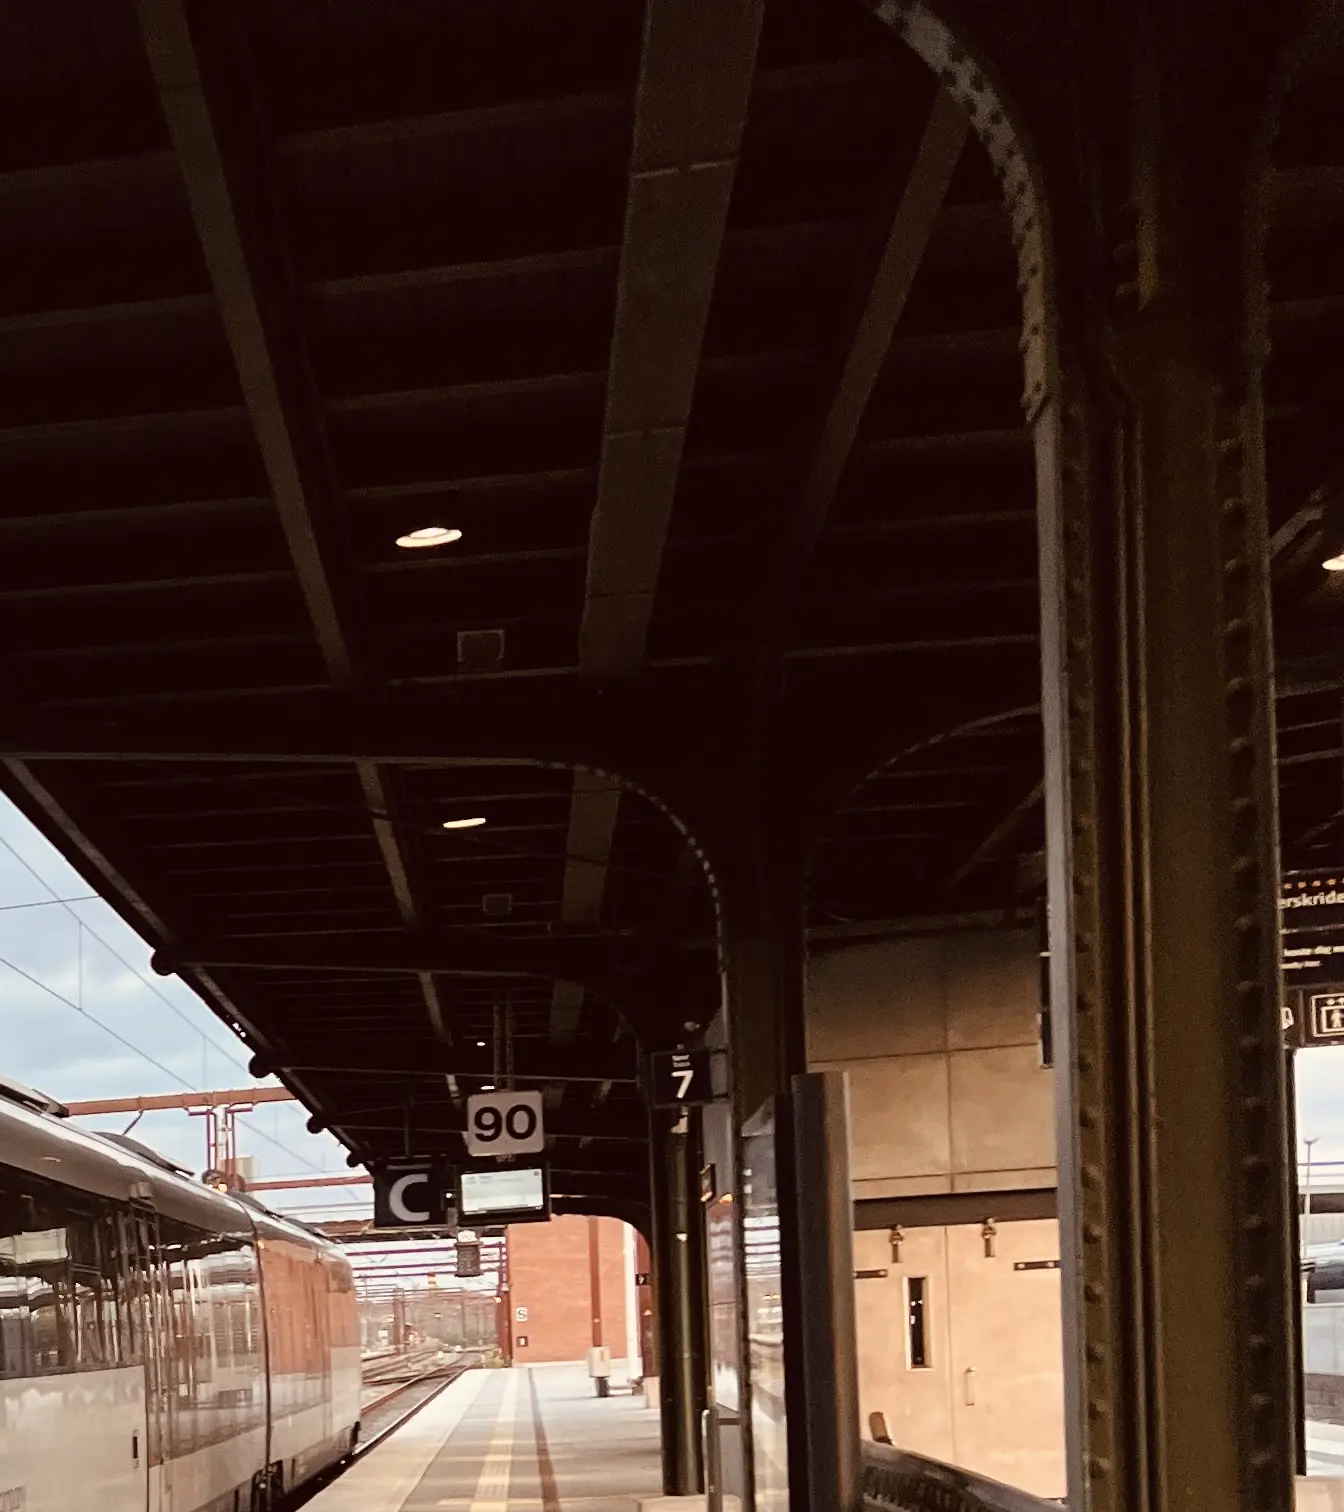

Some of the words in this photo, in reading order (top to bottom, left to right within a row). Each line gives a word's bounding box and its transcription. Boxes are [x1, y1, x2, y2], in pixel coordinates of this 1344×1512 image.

[671, 1070, 694, 1099] 7
[474, 1104, 537, 1142] 90
[389, 1173, 431, 1222] C
